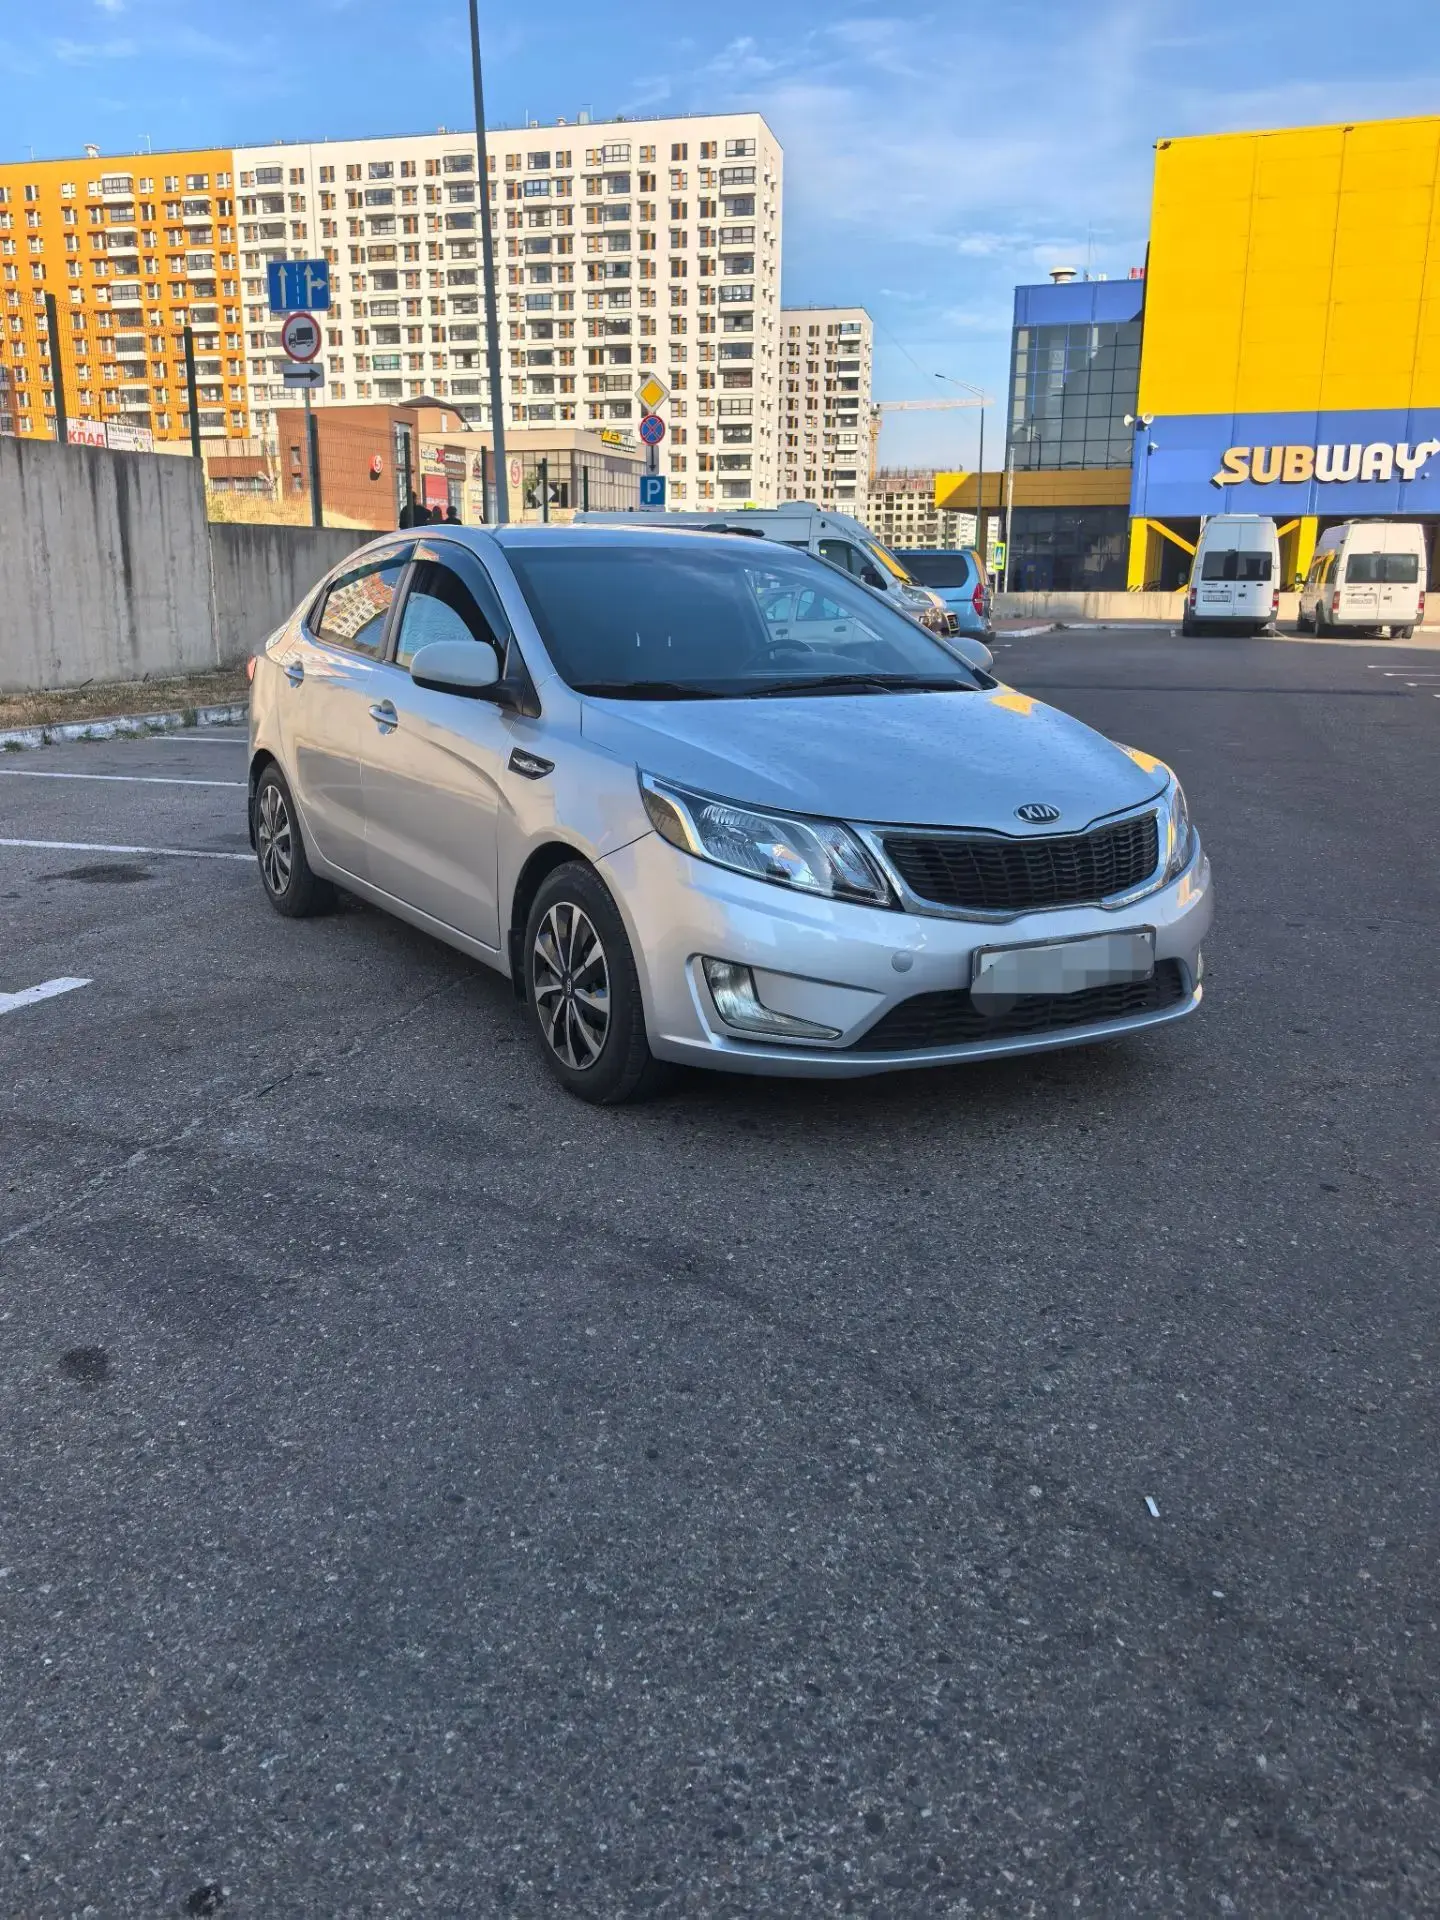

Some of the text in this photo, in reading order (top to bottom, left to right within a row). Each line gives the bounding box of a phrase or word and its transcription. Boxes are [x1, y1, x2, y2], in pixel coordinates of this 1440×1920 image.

[1212, 438, 1440, 487] SUBWAY
[647, 479, 661, 502] P
[1021, 803, 1058, 819] KIA
